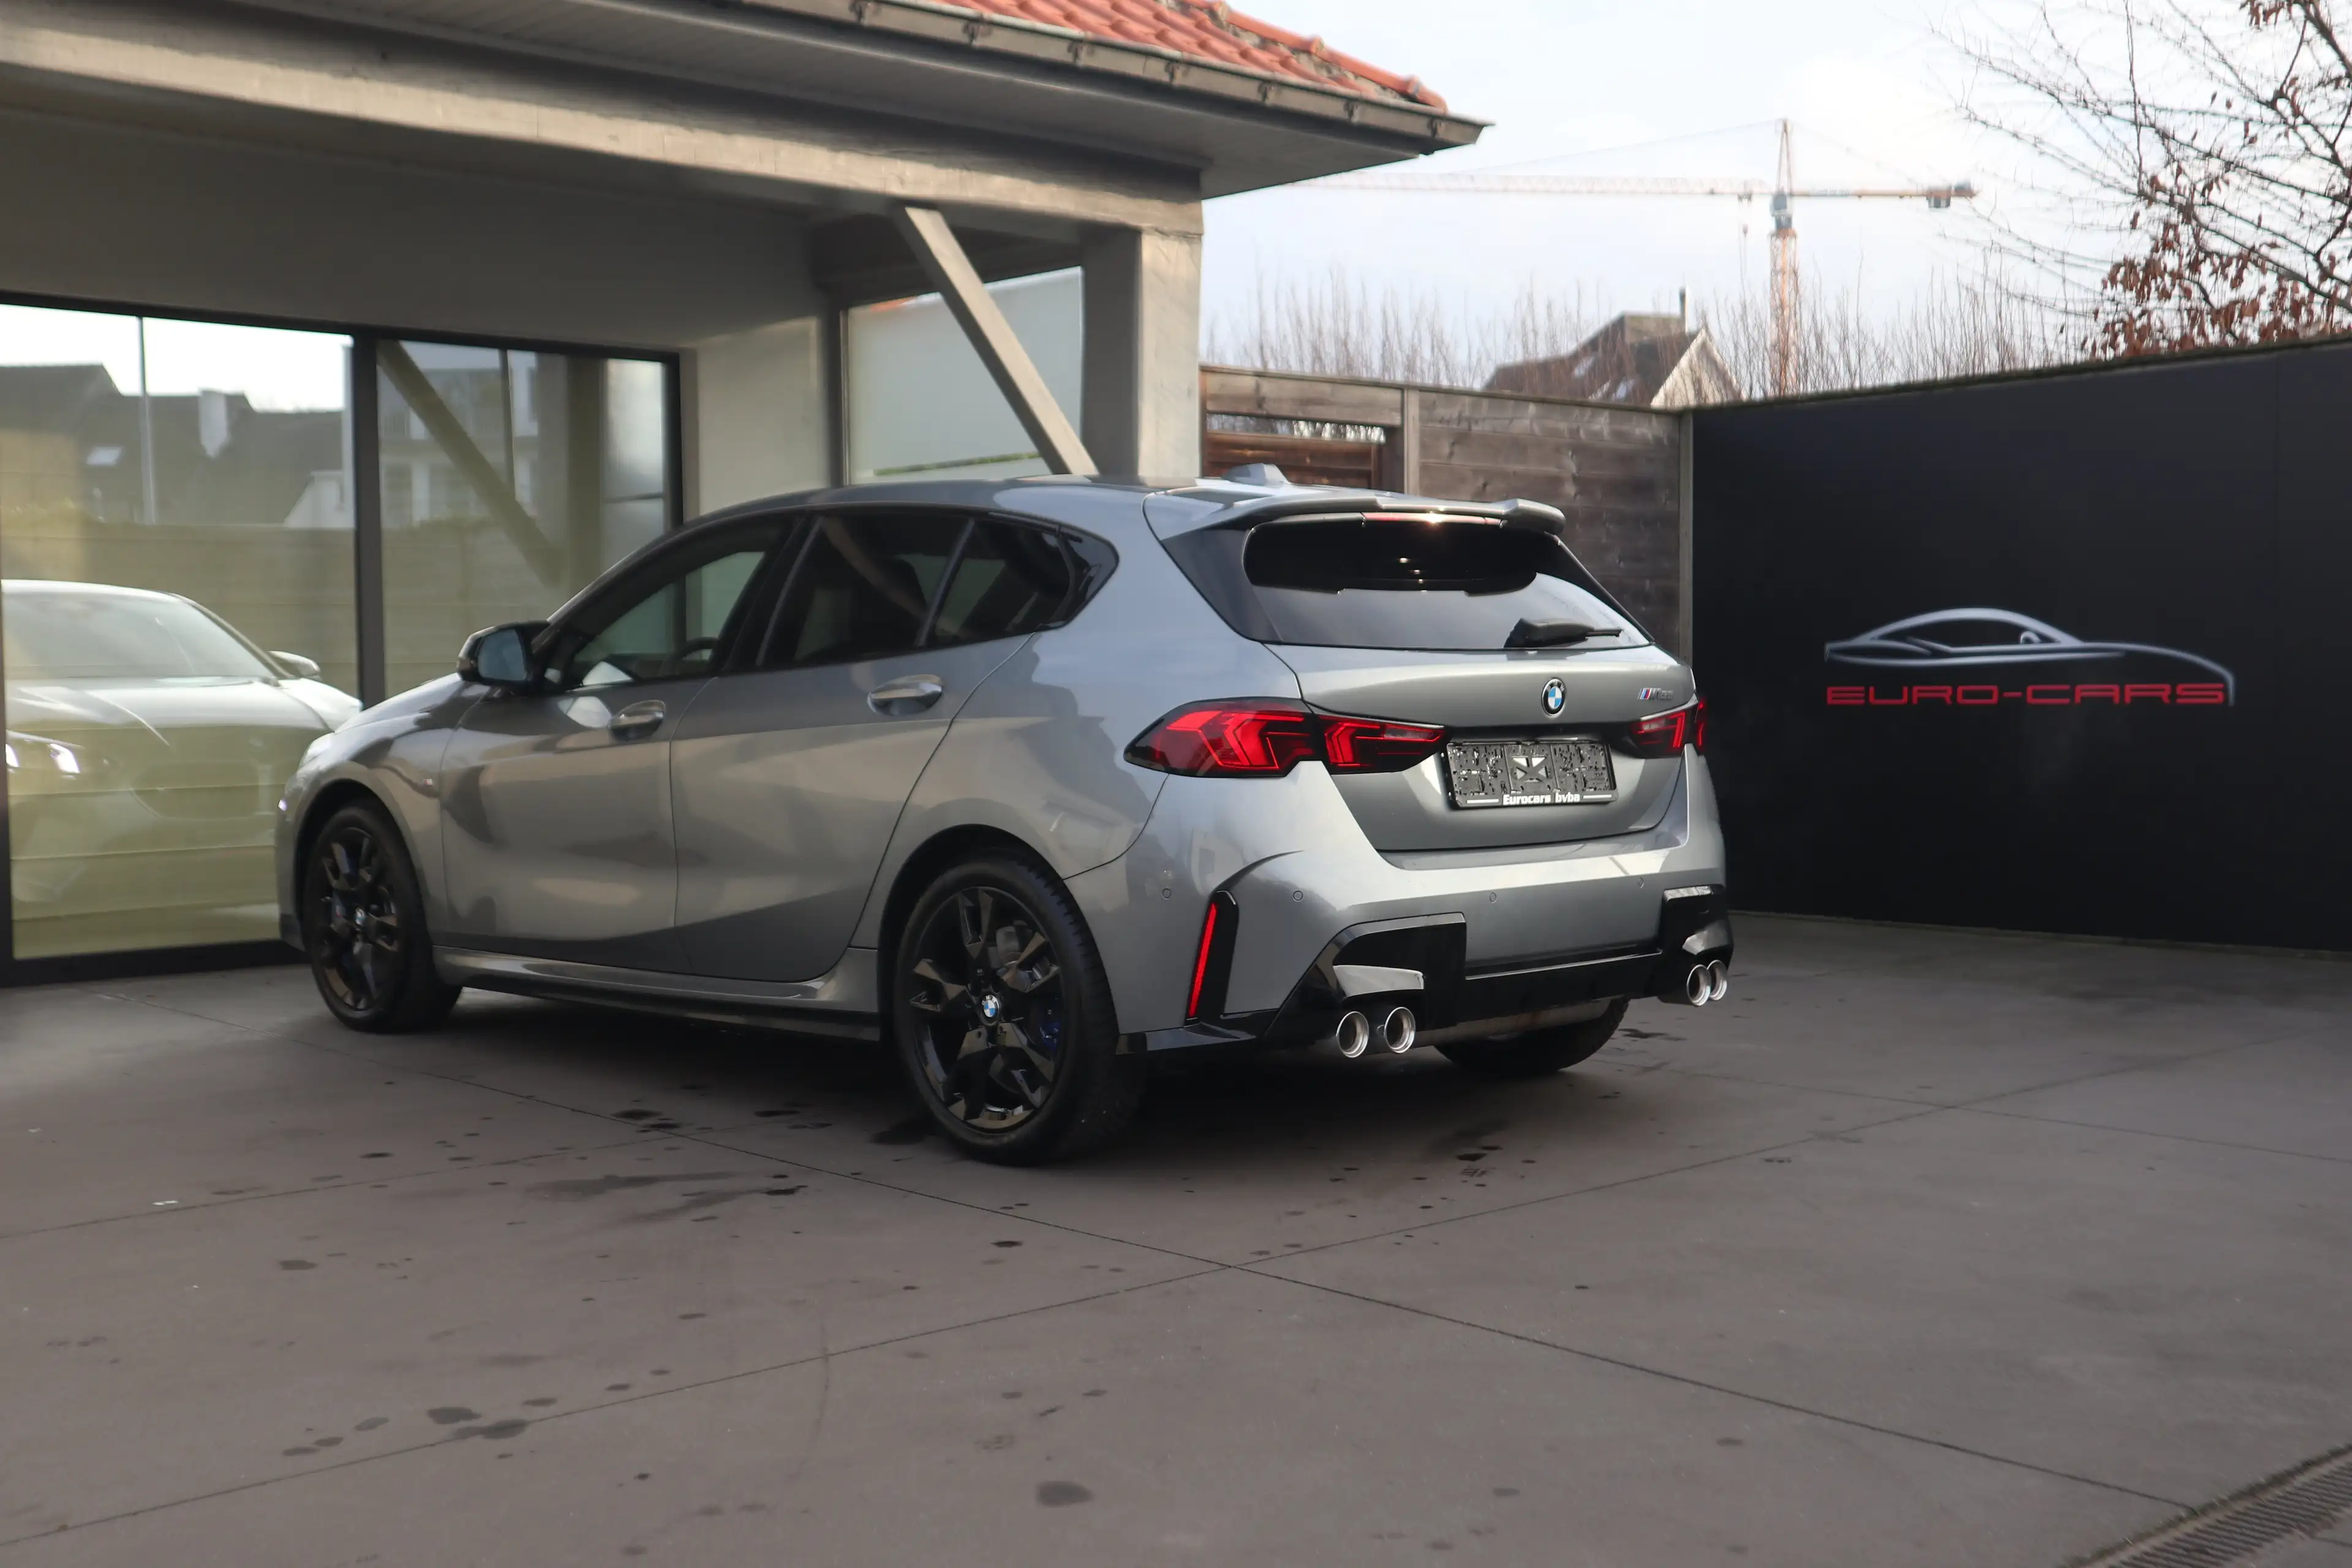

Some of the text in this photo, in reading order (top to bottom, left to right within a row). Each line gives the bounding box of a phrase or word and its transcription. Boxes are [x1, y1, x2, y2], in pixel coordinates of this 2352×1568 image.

[1826, 684, 2225, 704] EURO-CARS
[1502, 792, 1580, 805] Eurocars bvba
